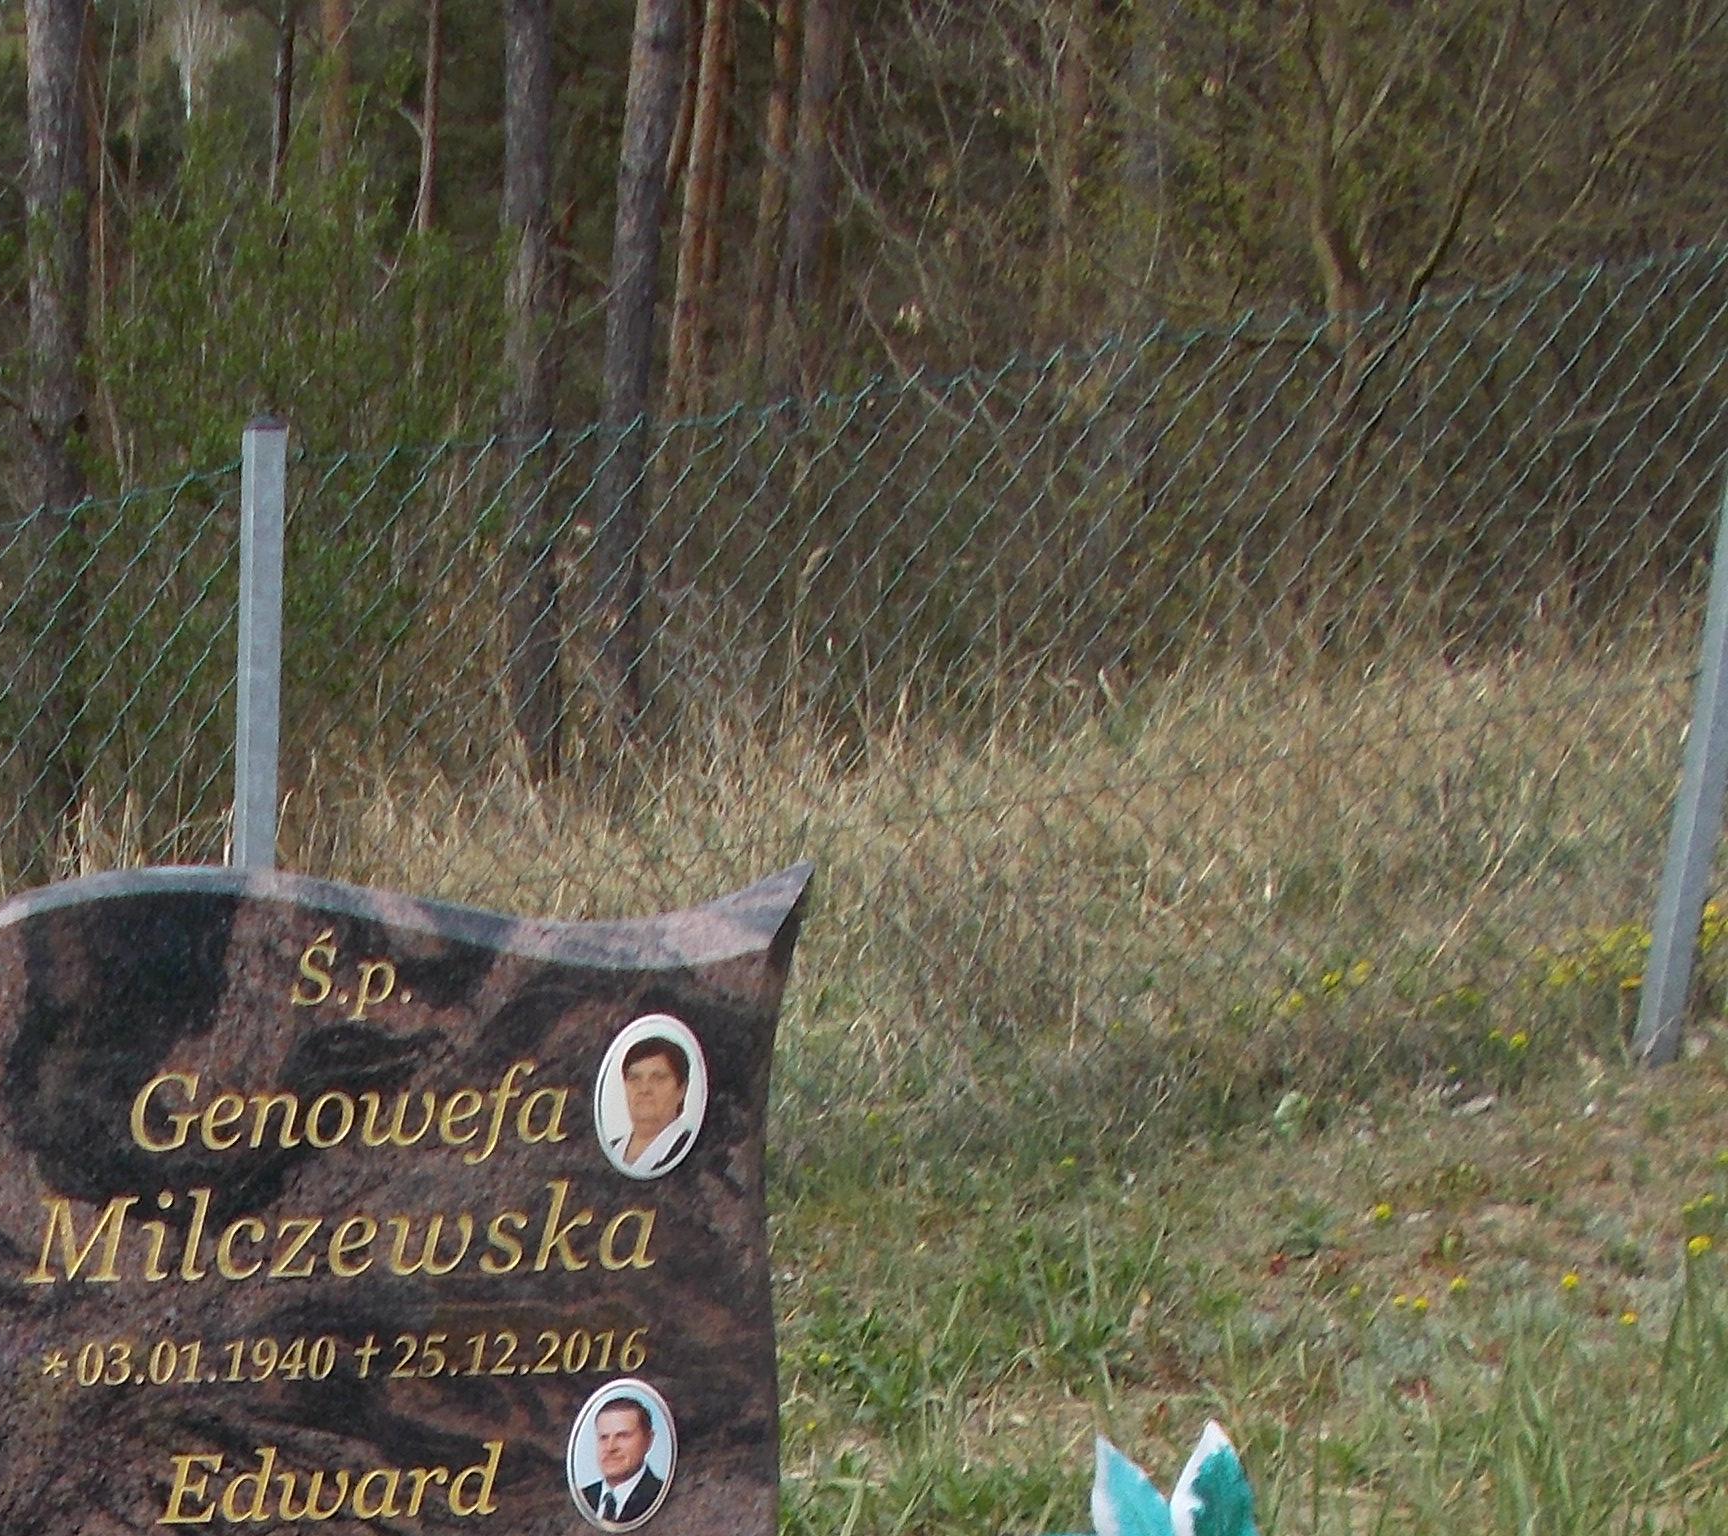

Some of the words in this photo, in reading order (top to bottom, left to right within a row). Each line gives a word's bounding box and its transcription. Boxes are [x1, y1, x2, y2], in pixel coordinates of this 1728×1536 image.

[291, 930, 414, 1021] Ś.p.
[130, 1060, 570, 1165] Genowefa
[23, 1179, 658, 1285] Milczewska
[389, 1325, 650, 1379] 25.12.2016
[156, 1441, 504, 1526] Edward
